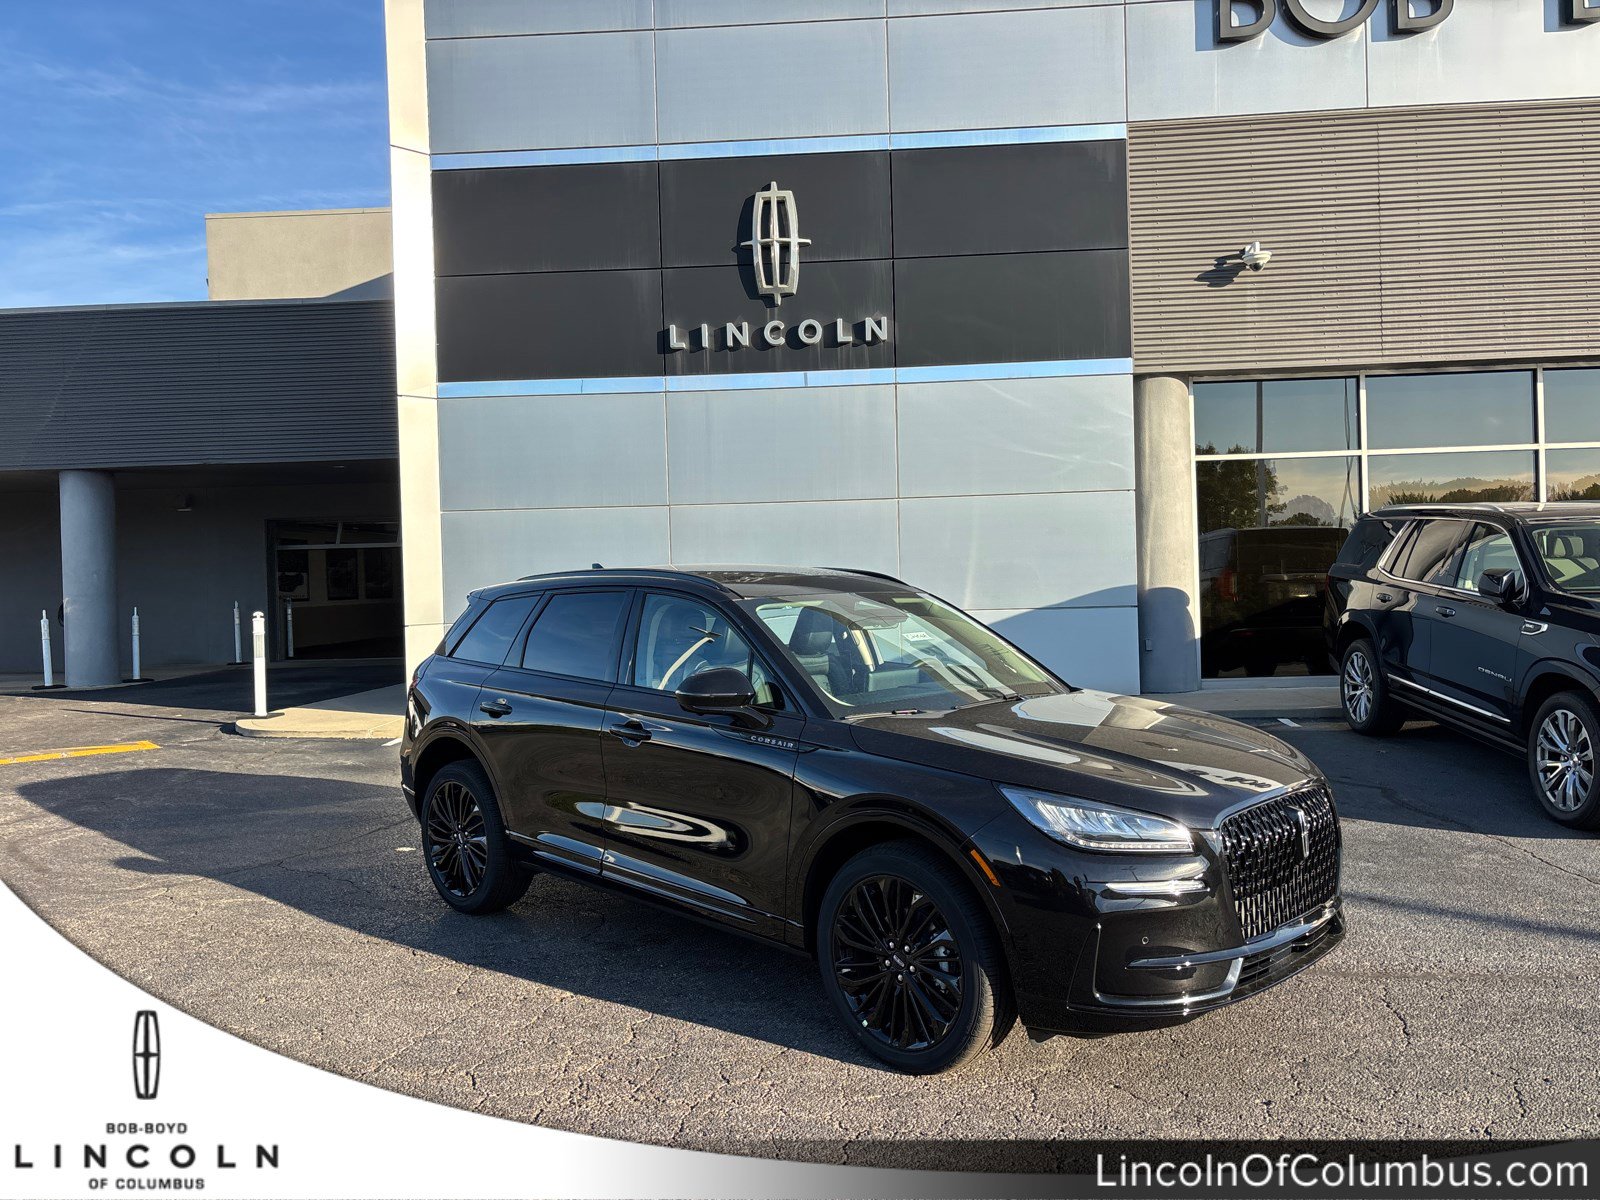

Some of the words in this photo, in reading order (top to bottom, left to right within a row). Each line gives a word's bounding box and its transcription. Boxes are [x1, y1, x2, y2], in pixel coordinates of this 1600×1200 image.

[669, 316, 889, 350] LINCOLN
[1477, 666, 1512, 683] DENALI
[750, 735, 795, 749] CORSAIR
